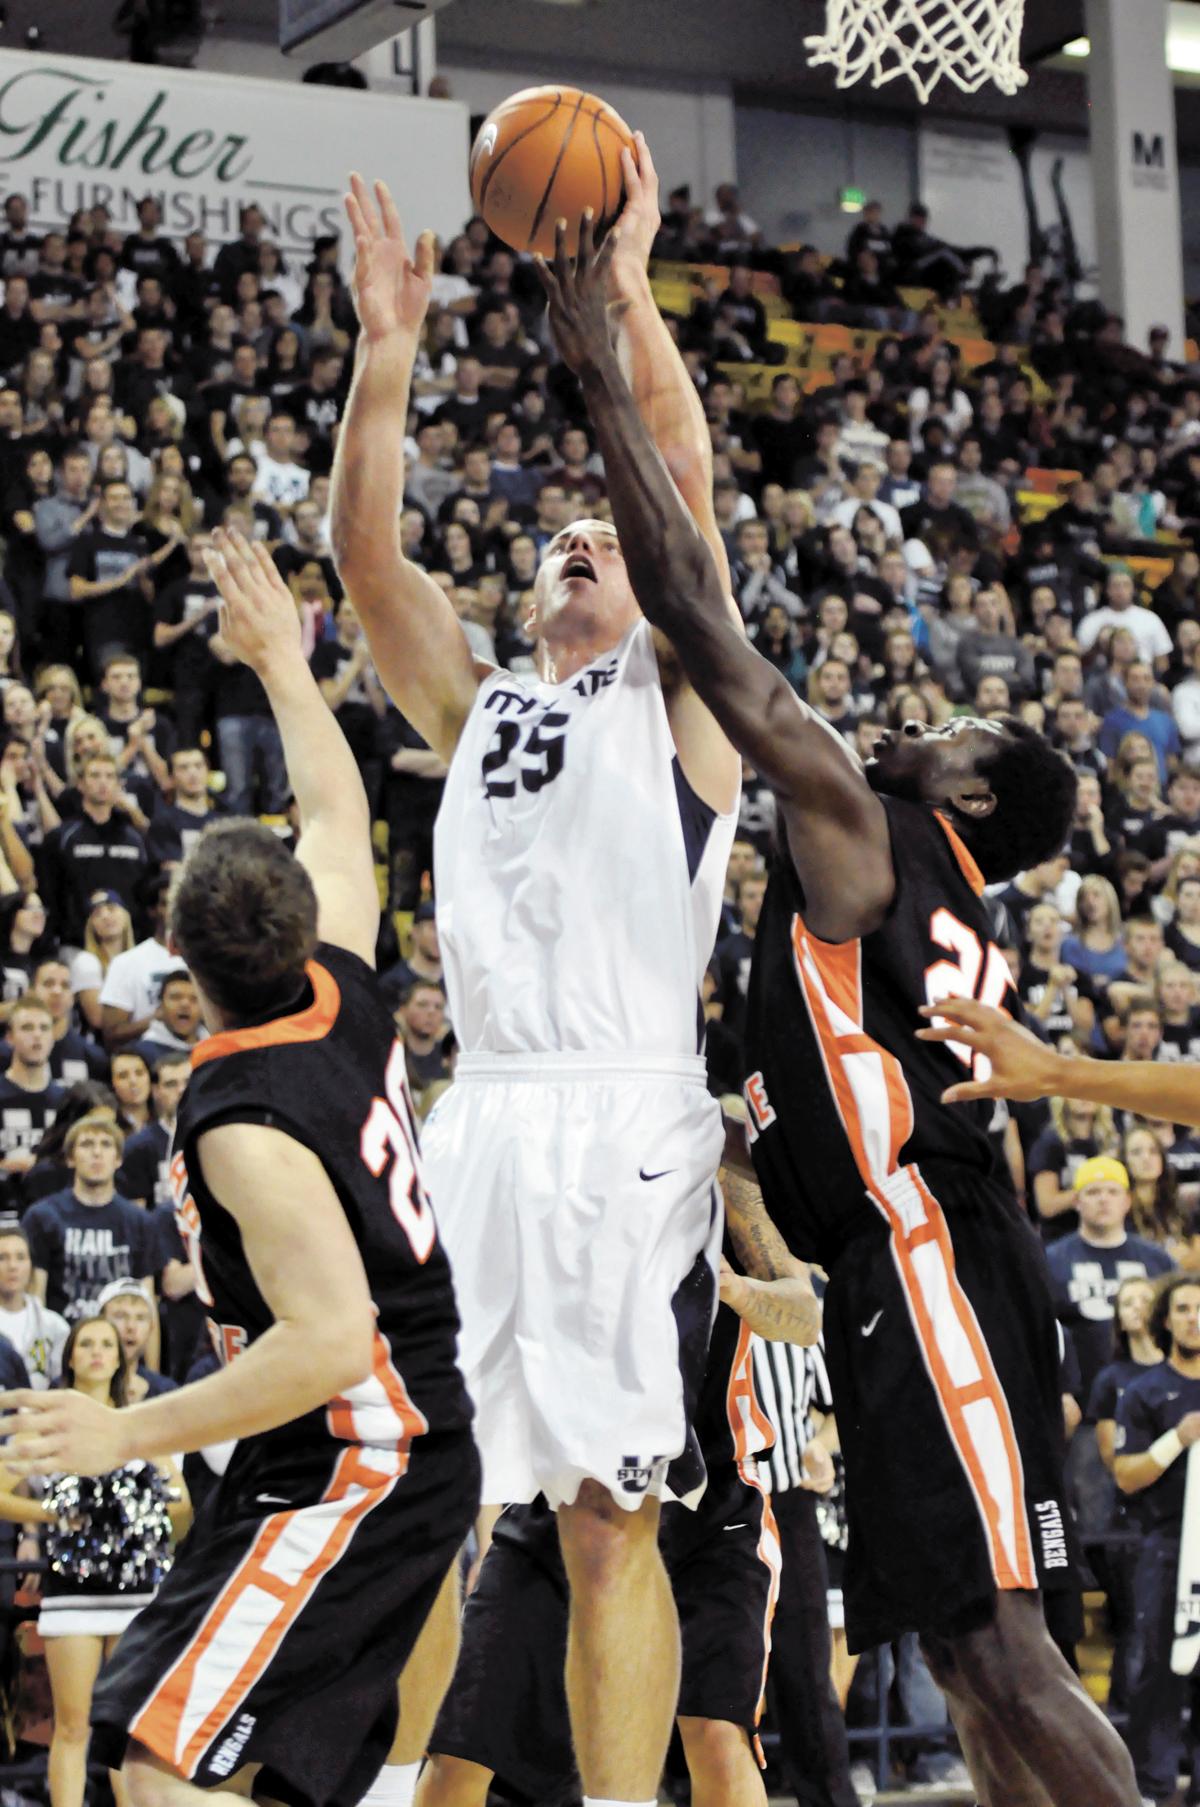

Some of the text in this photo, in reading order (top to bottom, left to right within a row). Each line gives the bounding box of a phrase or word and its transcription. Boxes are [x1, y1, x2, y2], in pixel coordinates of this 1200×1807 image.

[0, 67, 252, 183] Fisher
[1133, 132, 1165, 168] M
[482, 712, 571, 798] 25
[1035, 1500, 1069, 1569] BENGALS
[208, 1713, 257, 1777] BENGALS
